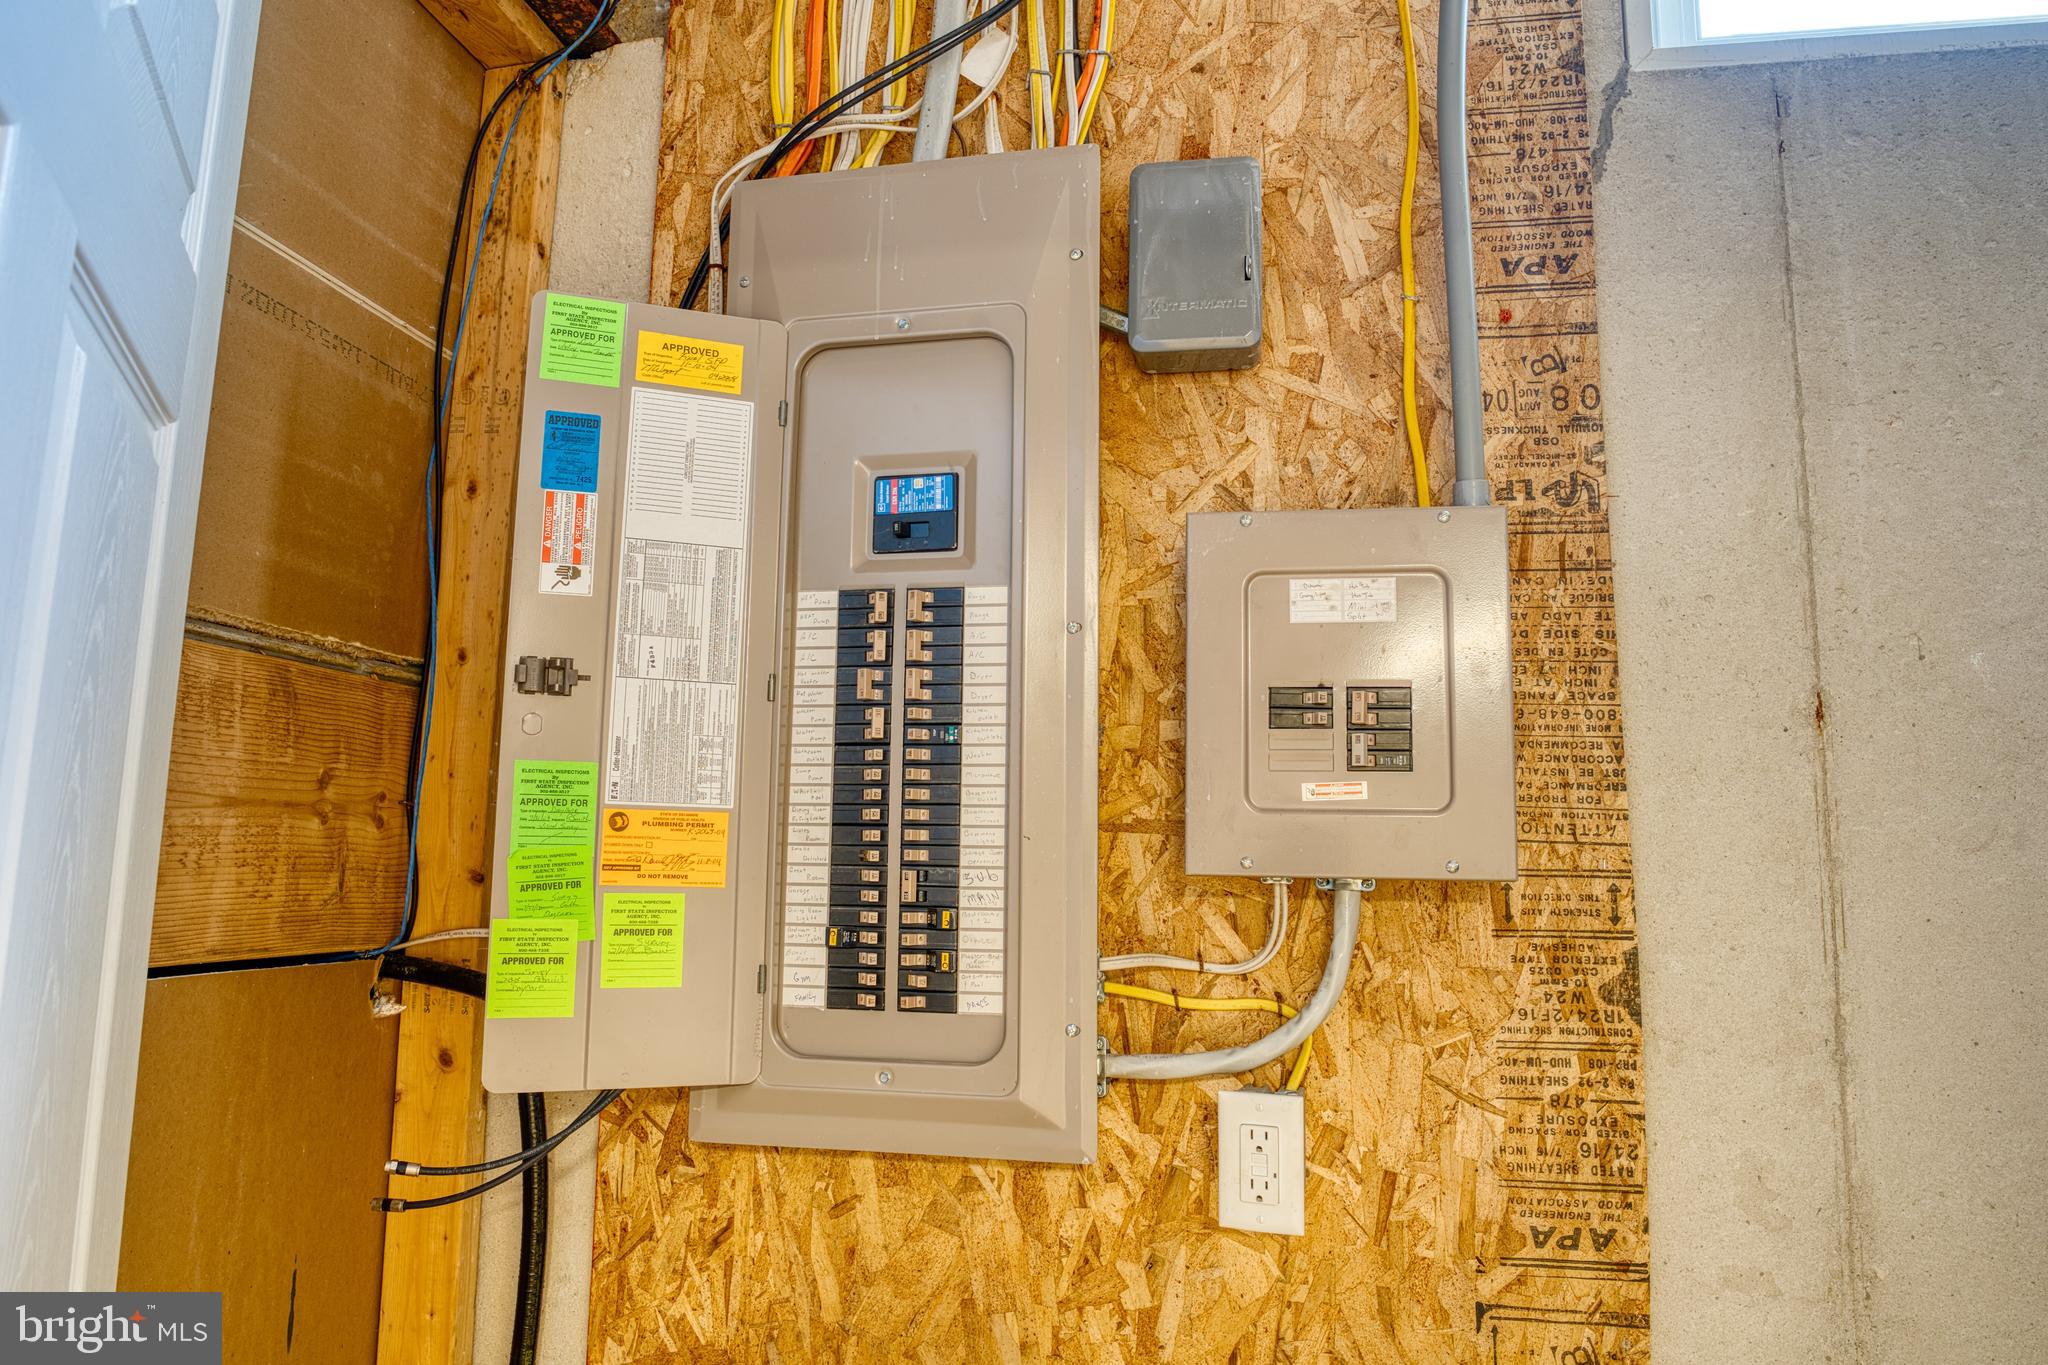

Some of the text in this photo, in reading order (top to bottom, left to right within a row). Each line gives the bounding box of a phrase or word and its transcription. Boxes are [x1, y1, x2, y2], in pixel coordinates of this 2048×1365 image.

[1496, 24, 1551, 35] ADHESIVE
[1516, 32, 1574, 43] EXTERIOR
[1534, 42, 1558, 50] CSA
[1505, 52, 1549, 61] 10.5mm
[1470, 94, 1517, 104] SHEATHING
[1470, 133, 1533, 145] SHEATHING
[1504, 162, 1577, 174] EXPOSURE
[1479, 175, 1522, 185] SPACING
[1531, 174, 1550, 182] FOR
[1471, 193, 1497, 202] INCH
[1479, 201, 1592, 216] RATED SHEATHING
[1480, 229, 1593, 243] WOOD ASSOCIATION
[1490, 240, 1584, 252] THE ENGINEERED
[1499, 253, 1580, 277] APA
[553, 301, 583, 310] ELECTRICAL
[586, 316, 617, 324] INSPECTION
[550, 328, 615, 343] APPROVED FOR
[662, 342, 720, 358] APPROVED
[1518, 388, 1540, 398] AUG
[1482, 389, 1509, 412] 04
[549, 415, 599, 428] APPROVED
[1485, 425, 1549, 435] THICKNESS
[1533, 437, 1559, 446] OSB
[544, 506, 552, 537] DANGER
[575, 507, 583, 539] PELIGRO
[1558, 577, 1573, 585] IN
[1542, 611, 1581, 621] LADO
[1543, 629, 1580, 639] SIDE
[1548, 647, 1564, 657] EN
[1568, 665, 1601, 675] INCH
[1533, 679, 1598, 688] INCH AT
[1567, 691, 1616, 701] SPACE
[1514, 723, 1611, 732] MORE INFORMATION
[612, 736, 620, 772] Cutler-Hammer
[1536, 754, 1623, 764] ACCORDANCE
[1579, 768, 1594, 777] BE
[520, 798, 588, 807] APPROVED FOR
[1518, 794, 1602, 805] FOR PROPER
[642, 820, 684, 828] PLUMBING
[1520, 821, 1617, 838] ATTENTIO
[520, 880, 582, 892] APPROVED FOR
[1520, 893, 1601, 902] THIS DIRECTION
[1520, 908, 1601, 918] STRENGTH AXIS
[613, 928, 673, 936] APPROVED FOR
[1530, 943, 1595, 952] ADHESIVE
[502, 957, 565, 966] APPROVED FOR
[1510, 954, 1618, 965] EXTERIOR TYPE
[1571, 966, 1599, 976] CSA
[1500, 1026, 1633, 1038] CONSTRUCTION SHEATHING
[1499, 1074, 1569, 1087] SHEATHING
[1536, 1114, 1619, 1127] EXPOSURE
[1508, 1126, 1556, 1136] SPACING
[1565, 1129, 1588, 1138] FOR
[1499, 1145, 1527, 1156] INCH
[1506, 1161, 1634, 1178] RATED SHEATHING
[1507, 1197, 1634, 1210] WOOD ASSOCIATION
[1519, 1209, 1622, 1222] THE ENGINEERED
[1529, 1225, 1618, 1253] APA
